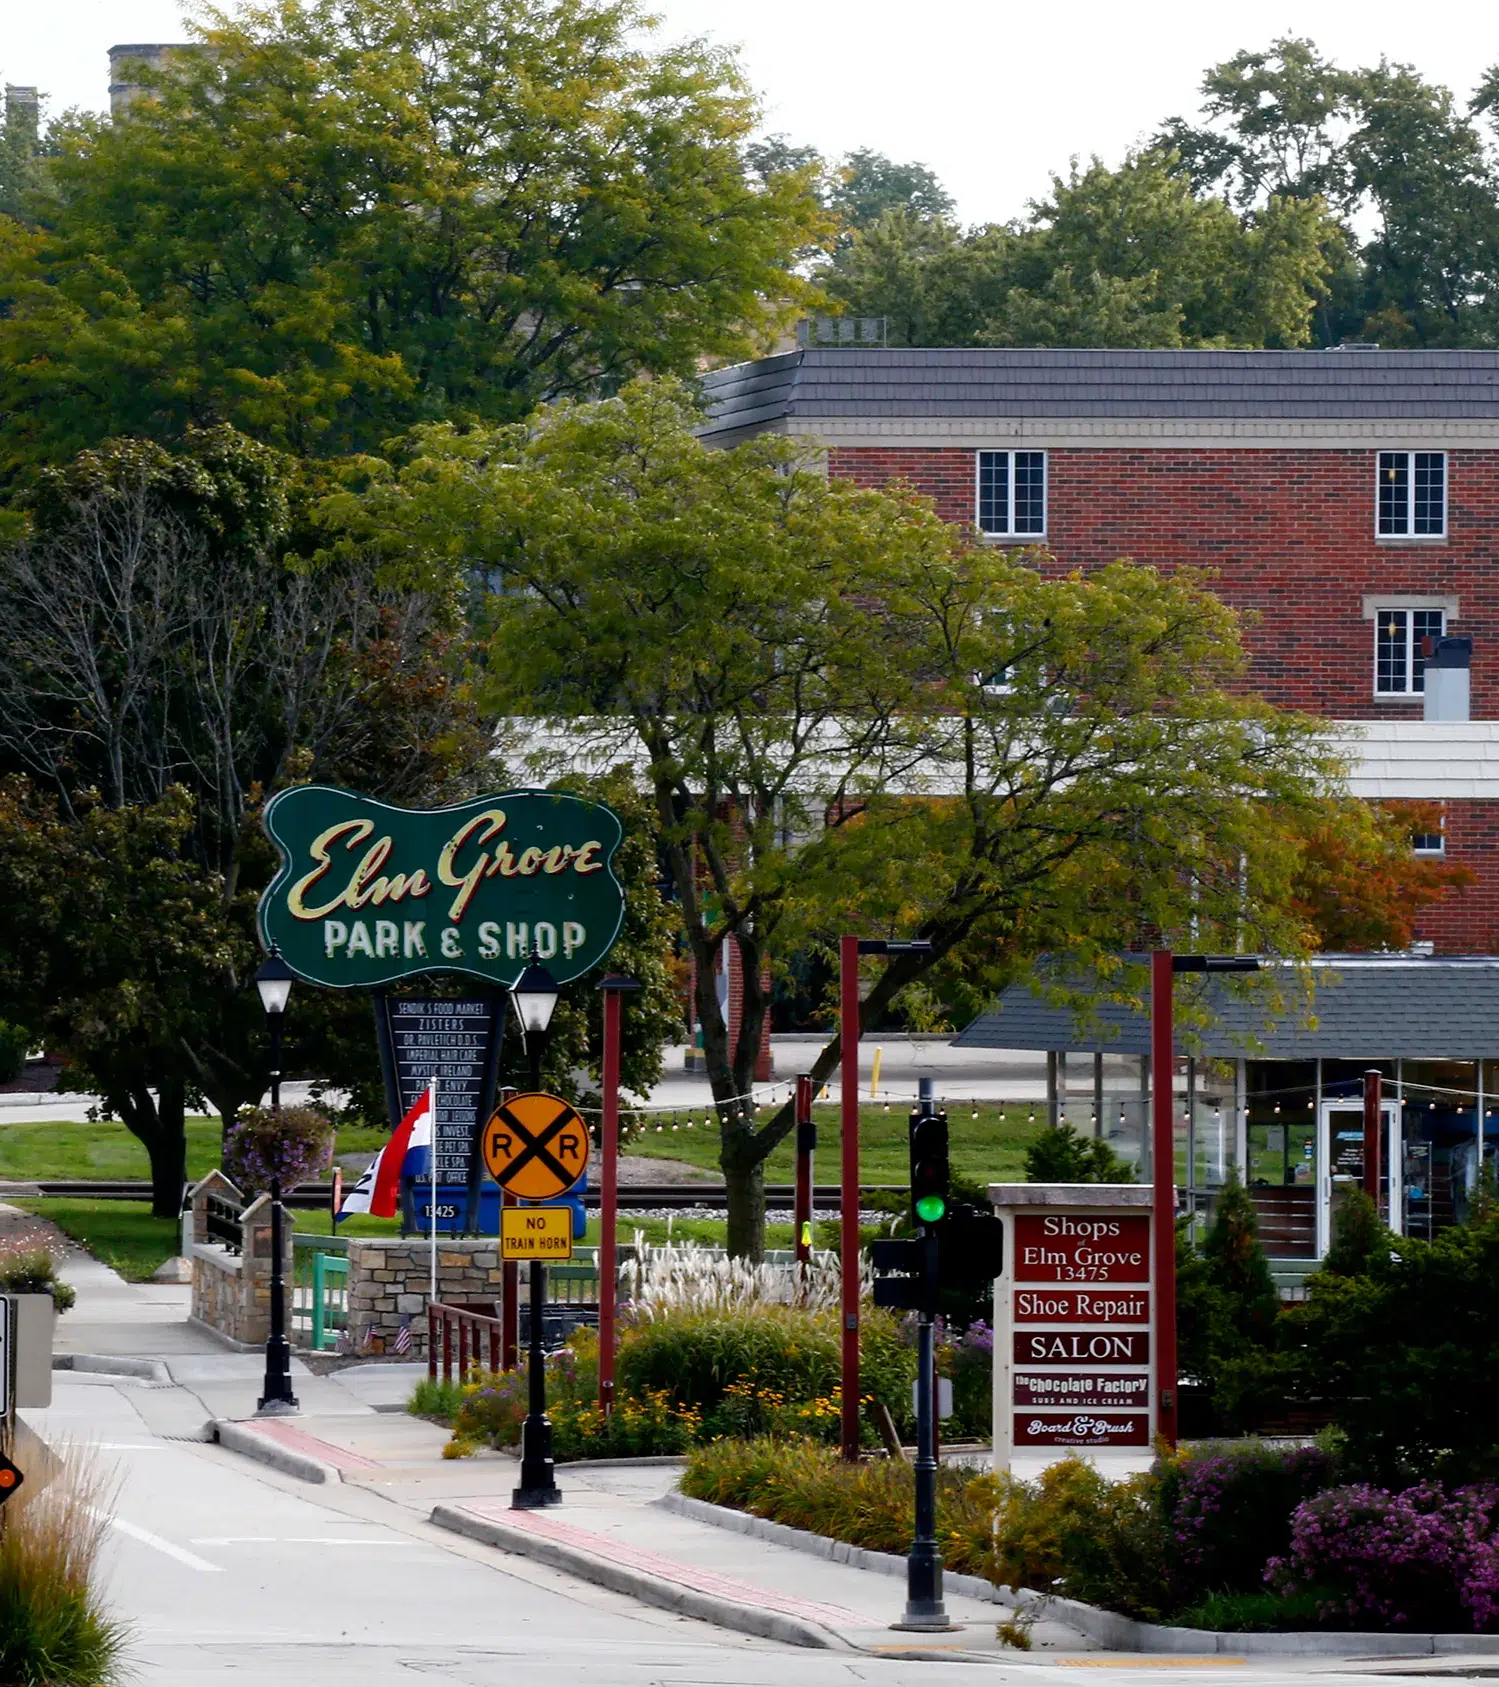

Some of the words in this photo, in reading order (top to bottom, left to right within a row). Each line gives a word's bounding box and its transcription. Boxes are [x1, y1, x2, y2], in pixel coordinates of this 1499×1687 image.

[287, 819, 431, 922] Elm
[438, 809, 603, 923] Grove
[324, 920, 429, 959] PARK
[441, 926, 465, 958] &
[478, 921, 586, 960] SHOP
[434, 1003, 453, 1014] FOOD
[456, 1004, 484, 1014] MARKET
[419, 1019, 464, 1030] ZISTERS
[406, 1050, 439, 1060] IMPERIAL
[441, 1050, 458, 1060] HAIR
[460, 1050, 477, 1061] CARE
[410, 1065, 438, 1076] MYSTIC
[440, 1065, 473, 1076] IRELAND
[445, 1080, 468, 1091] ENVY
[437, 1095, 472, 1106] CHOCOLATE
[445, 1141, 456, 1152] PET
[458, 1141, 469, 1152] SPA
[492, 1133, 512, 1158] R
[559, 1134, 579, 1159] R
[451, 1156, 465, 1168] SPA
[447, 1172, 467, 1183] OFFICE
[526, 1217, 546, 1229] NO
[1044, 1216, 1120, 1241] Shops
[505, 1237, 534, 1249] TRAIN
[539, 1237, 567, 1249] HORN
[1023, 1247, 1067, 1265] Elm
[1074, 1247, 1142, 1265] Grove
[1056, 1267, 1108, 1281] 13475
[1018, 1294, 1069, 1315] Shoe
[1075, 1294, 1145, 1321] Repair
[1031, 1336, 1134, 1358] SALON
[1015, 1376, 1029, 1385] the
[1029, 1377, 1093, 1393] Chocolate
[1097, 1378, 1147, 1393] Factory
[1027, 1420, 1072, 1435] Board
[1072, 1416, 1095, 1435] &
[1092, 1420, 1134, 1435] Brush
[1054, 1436, 1084, 1444] creative
[1086, 1436, 1110, 1444] studio
